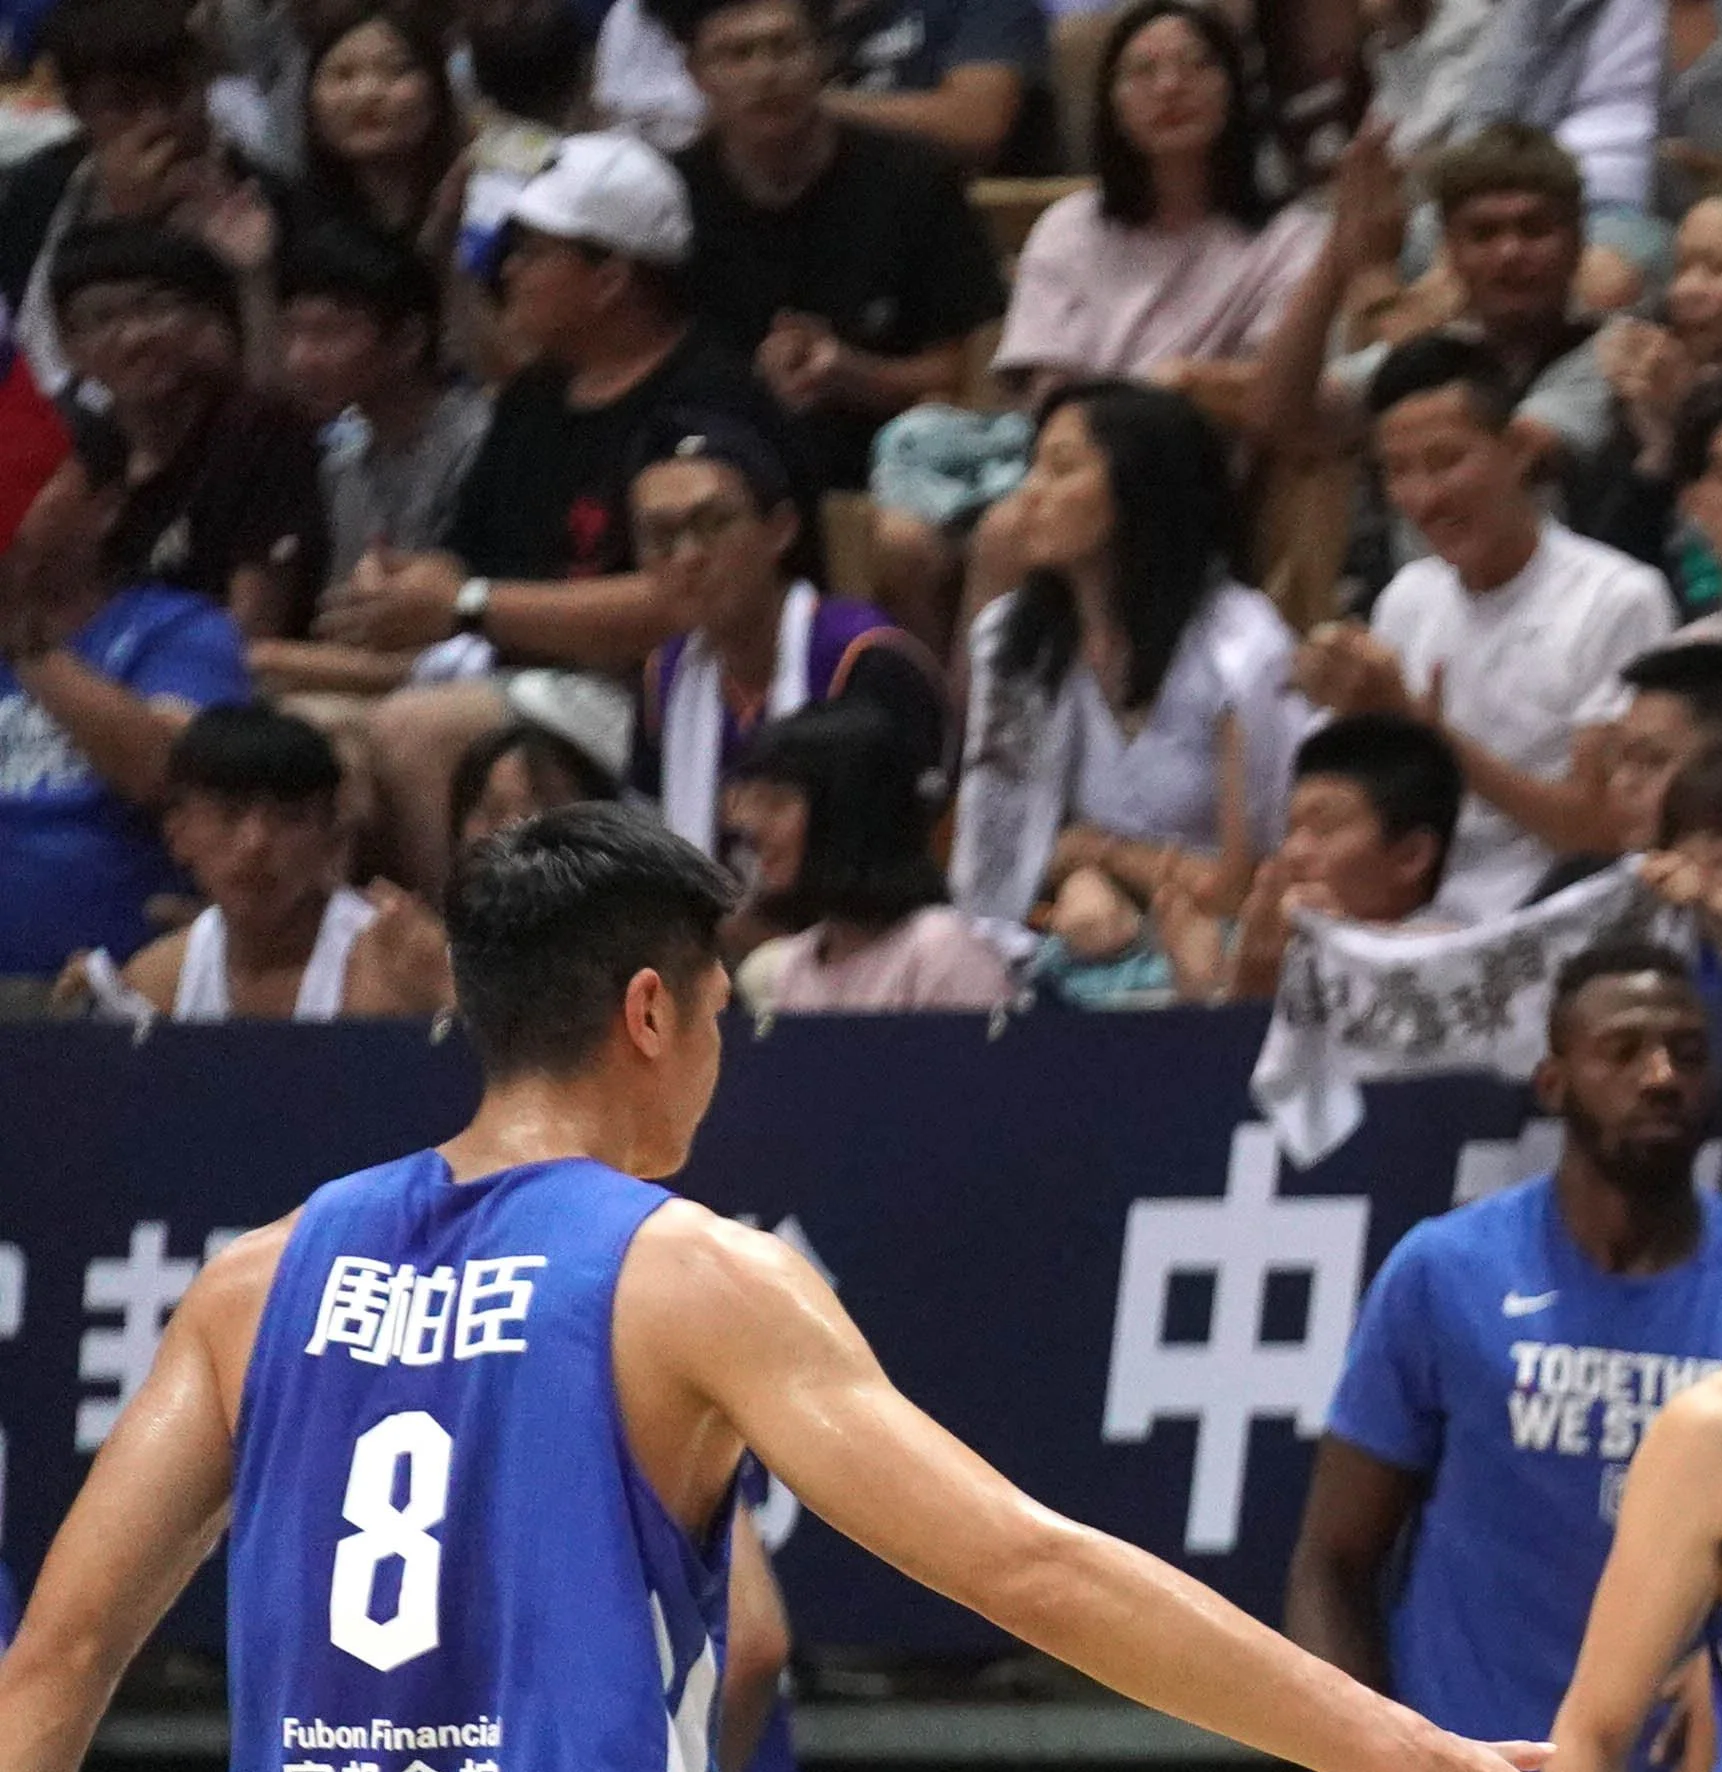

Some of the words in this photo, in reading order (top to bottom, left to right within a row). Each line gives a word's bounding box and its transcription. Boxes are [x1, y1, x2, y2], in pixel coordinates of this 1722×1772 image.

[1508, 1388, 1590, 1456] WE
[330, 1410, 453, 1673] 8
[282, 1716, 369, 1751] Fubon
